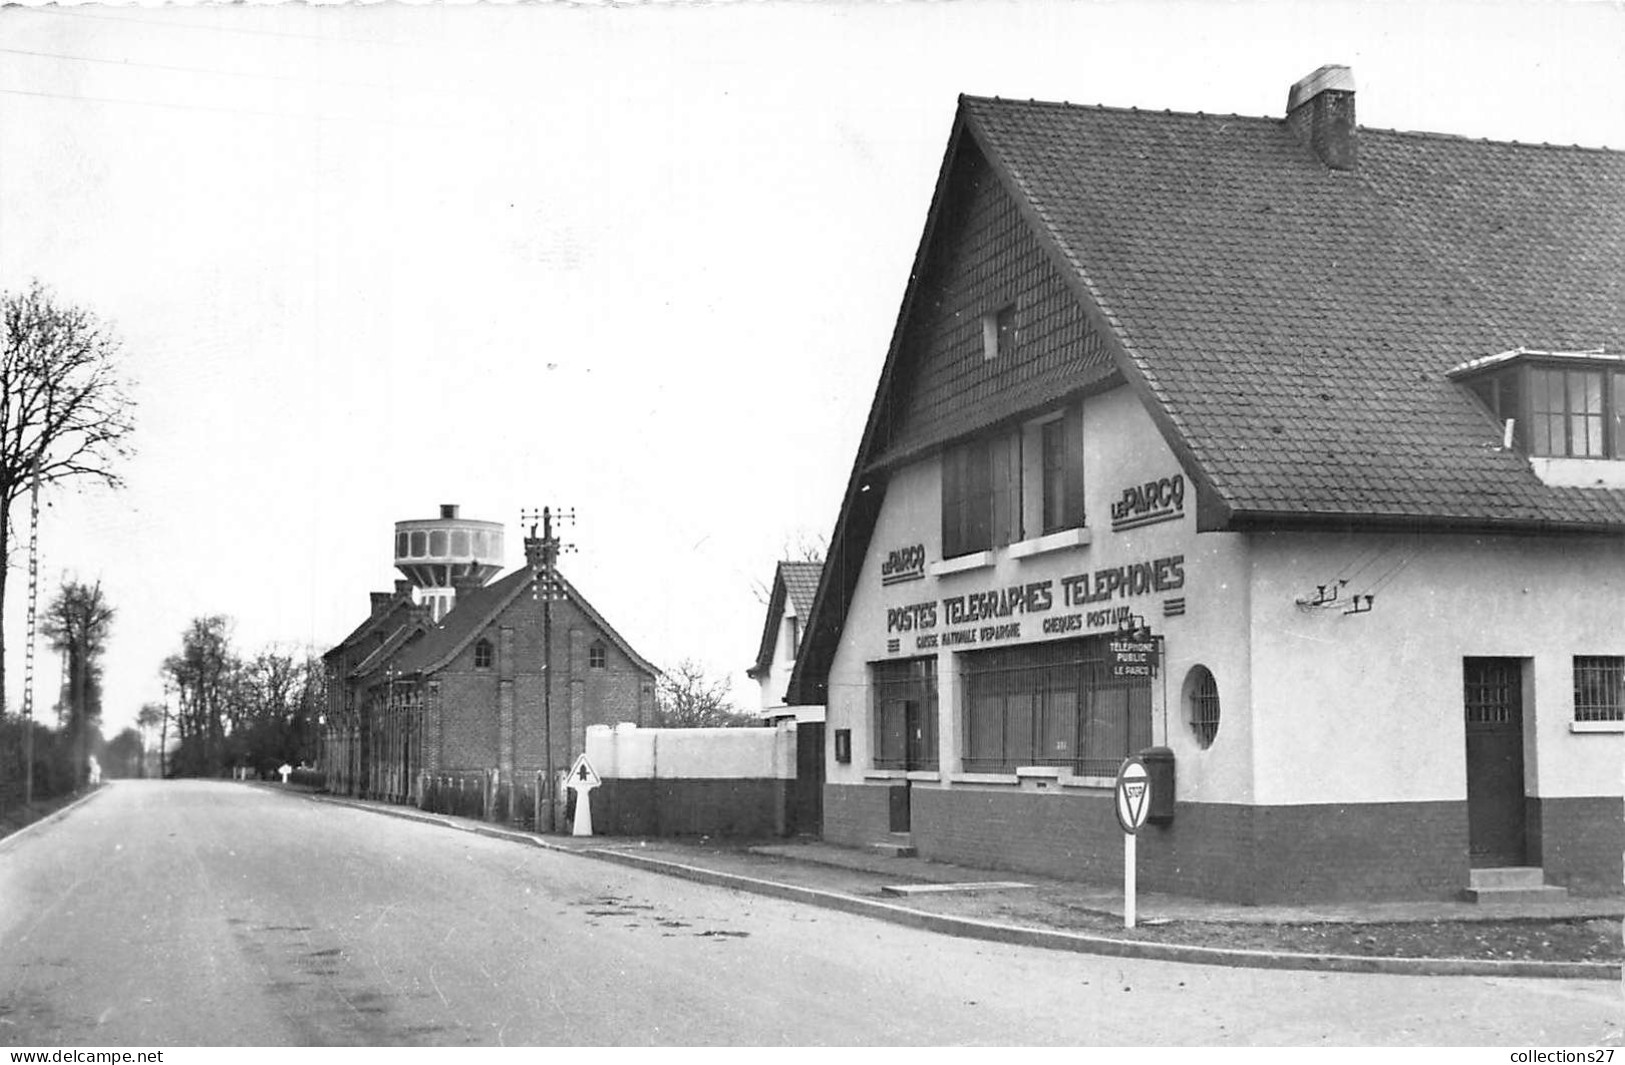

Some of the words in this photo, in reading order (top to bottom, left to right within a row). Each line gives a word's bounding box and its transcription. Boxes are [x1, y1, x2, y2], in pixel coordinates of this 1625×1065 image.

[1111, 501, 1125, 519] LE
[1122, 474, 1184, 516] PARCQ
[889, 544, 925, 573] PARCQ
[887, 601, 937, 633] POSTES
[942, 580, 1053, 625] TELEGRAPHES
[1061, 555, 1184, 606] TELEPHONES
[1042, 613, 1082, 634] CHEQUES
[1116, 653, 1147, 662] PUBLIC
[1114, 666, 1124, 675] LE
[1128, 786, 1143, 799] STOP
